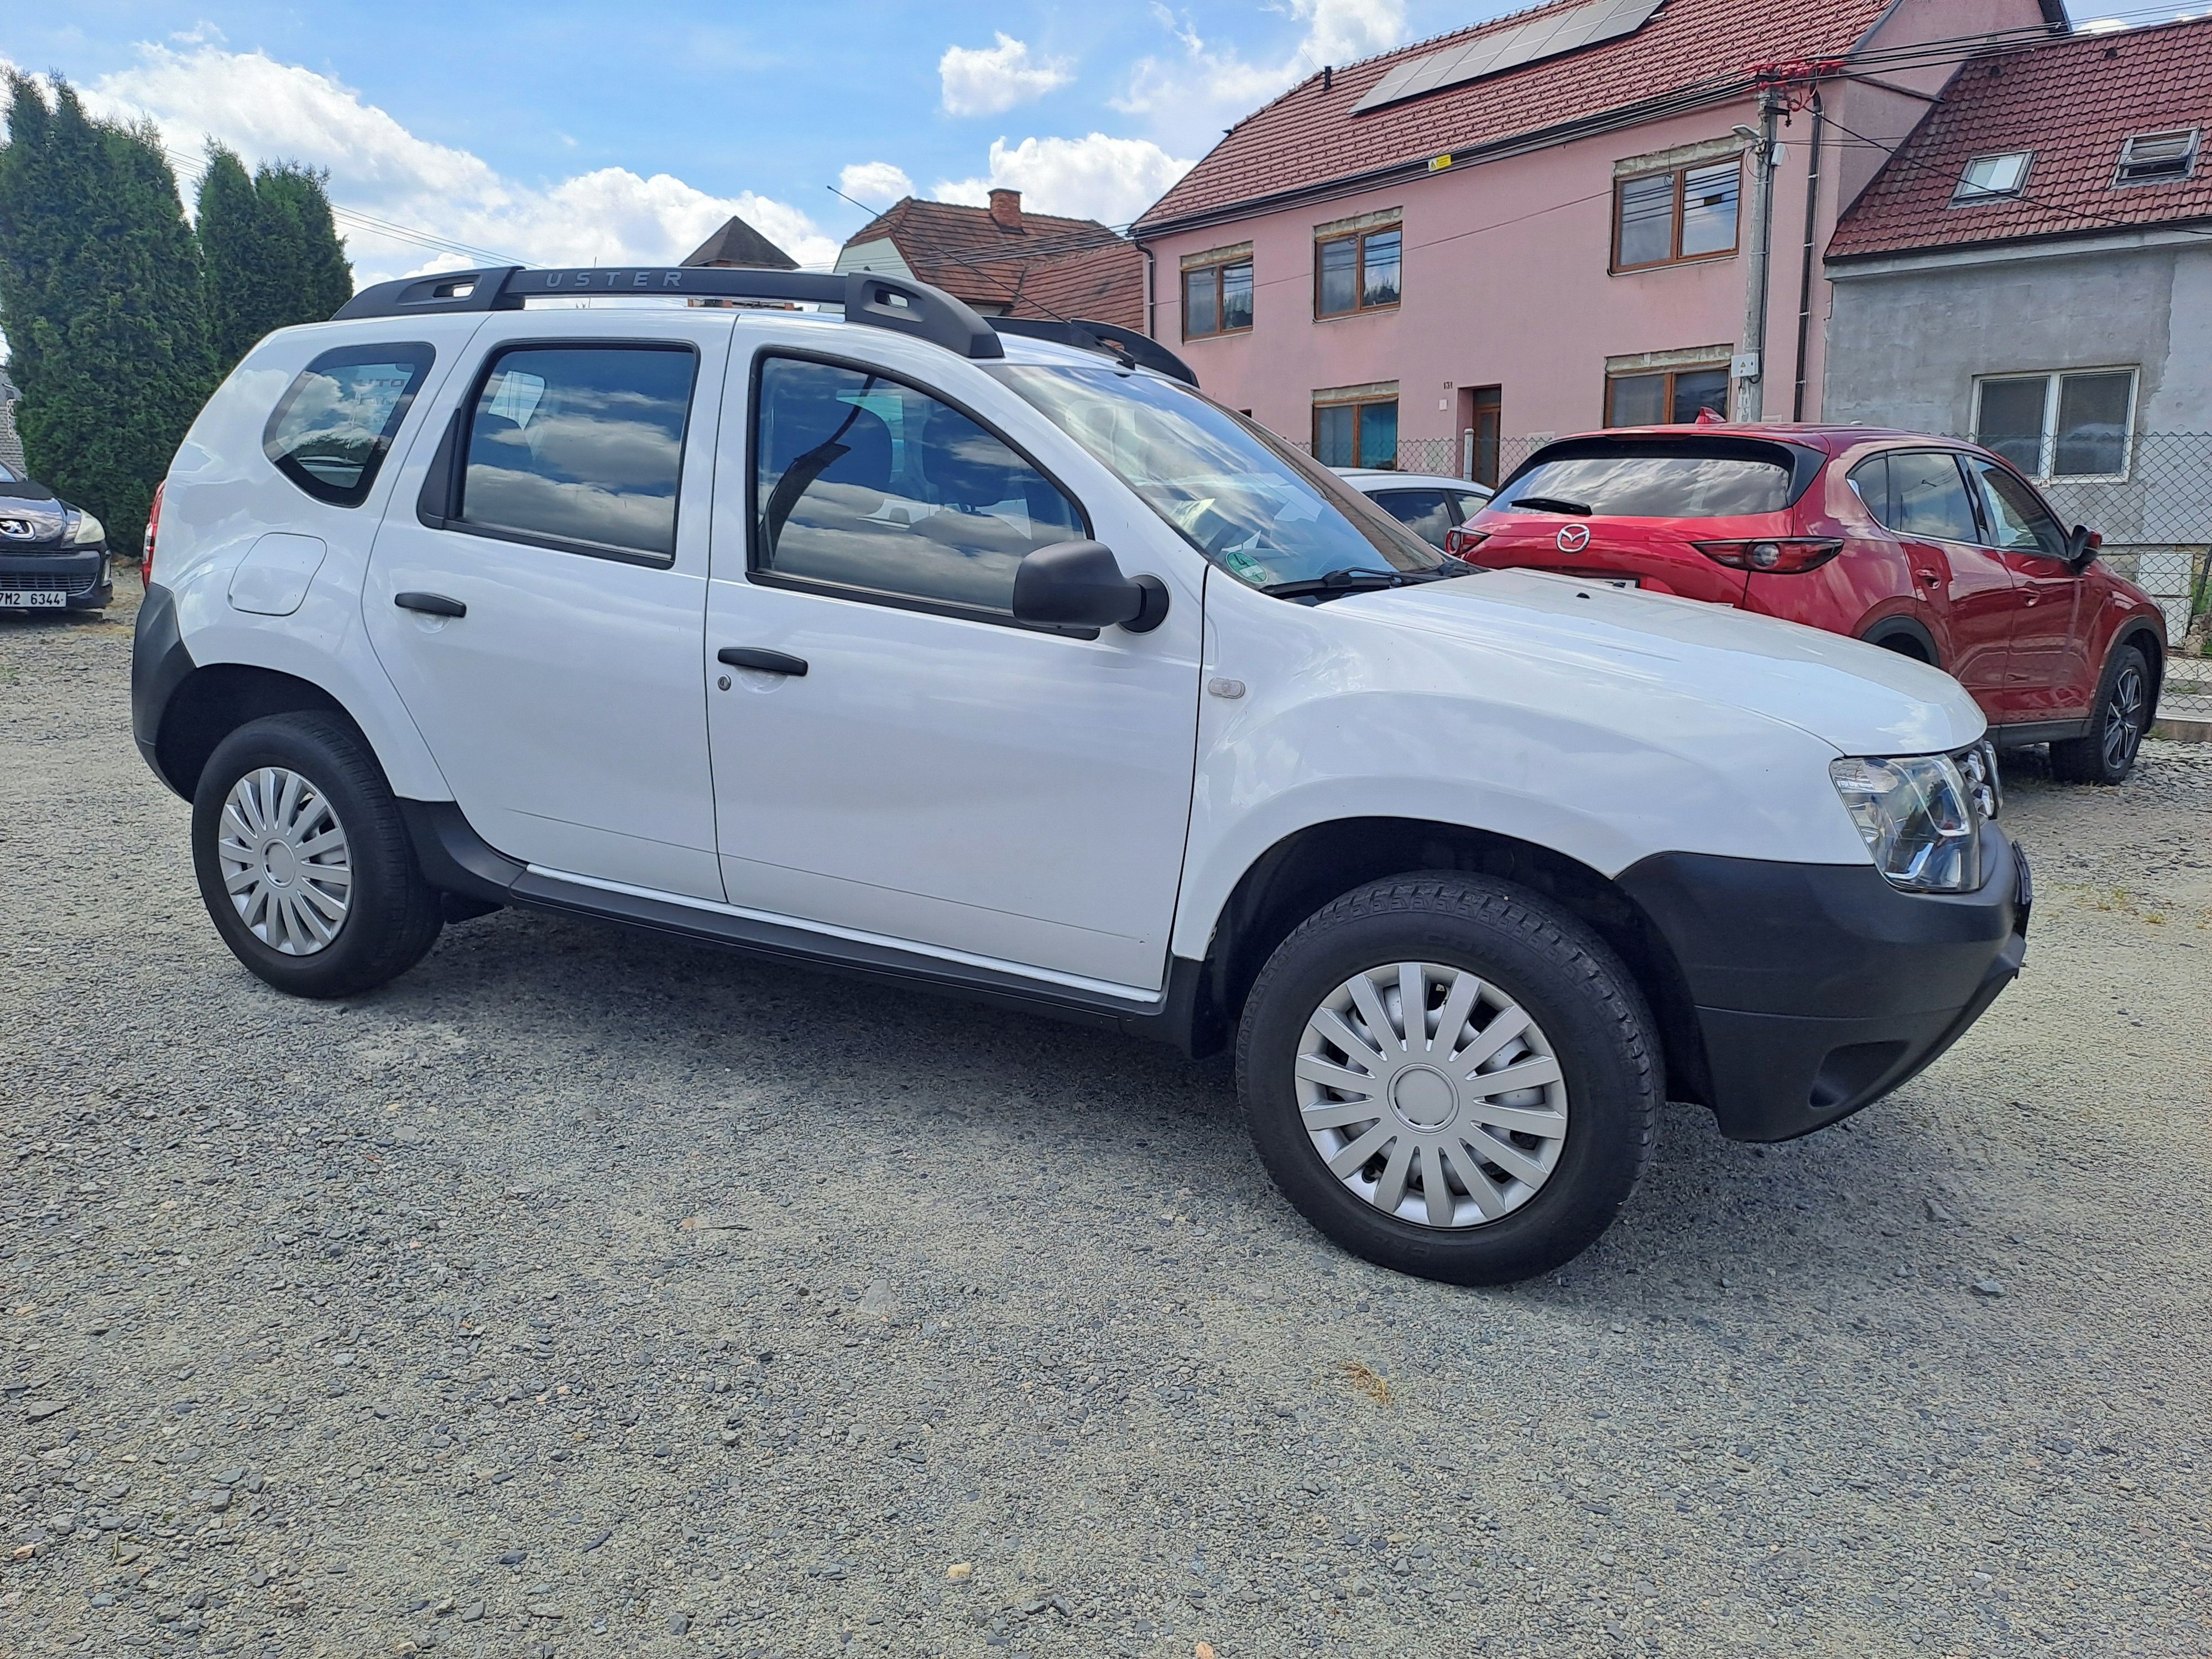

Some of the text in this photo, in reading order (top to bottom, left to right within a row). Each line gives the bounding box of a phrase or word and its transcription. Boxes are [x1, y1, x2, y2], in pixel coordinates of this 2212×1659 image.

[1232, 554, 1250, 567] 4
[0, 592, 60, 605] 7M2 6344
